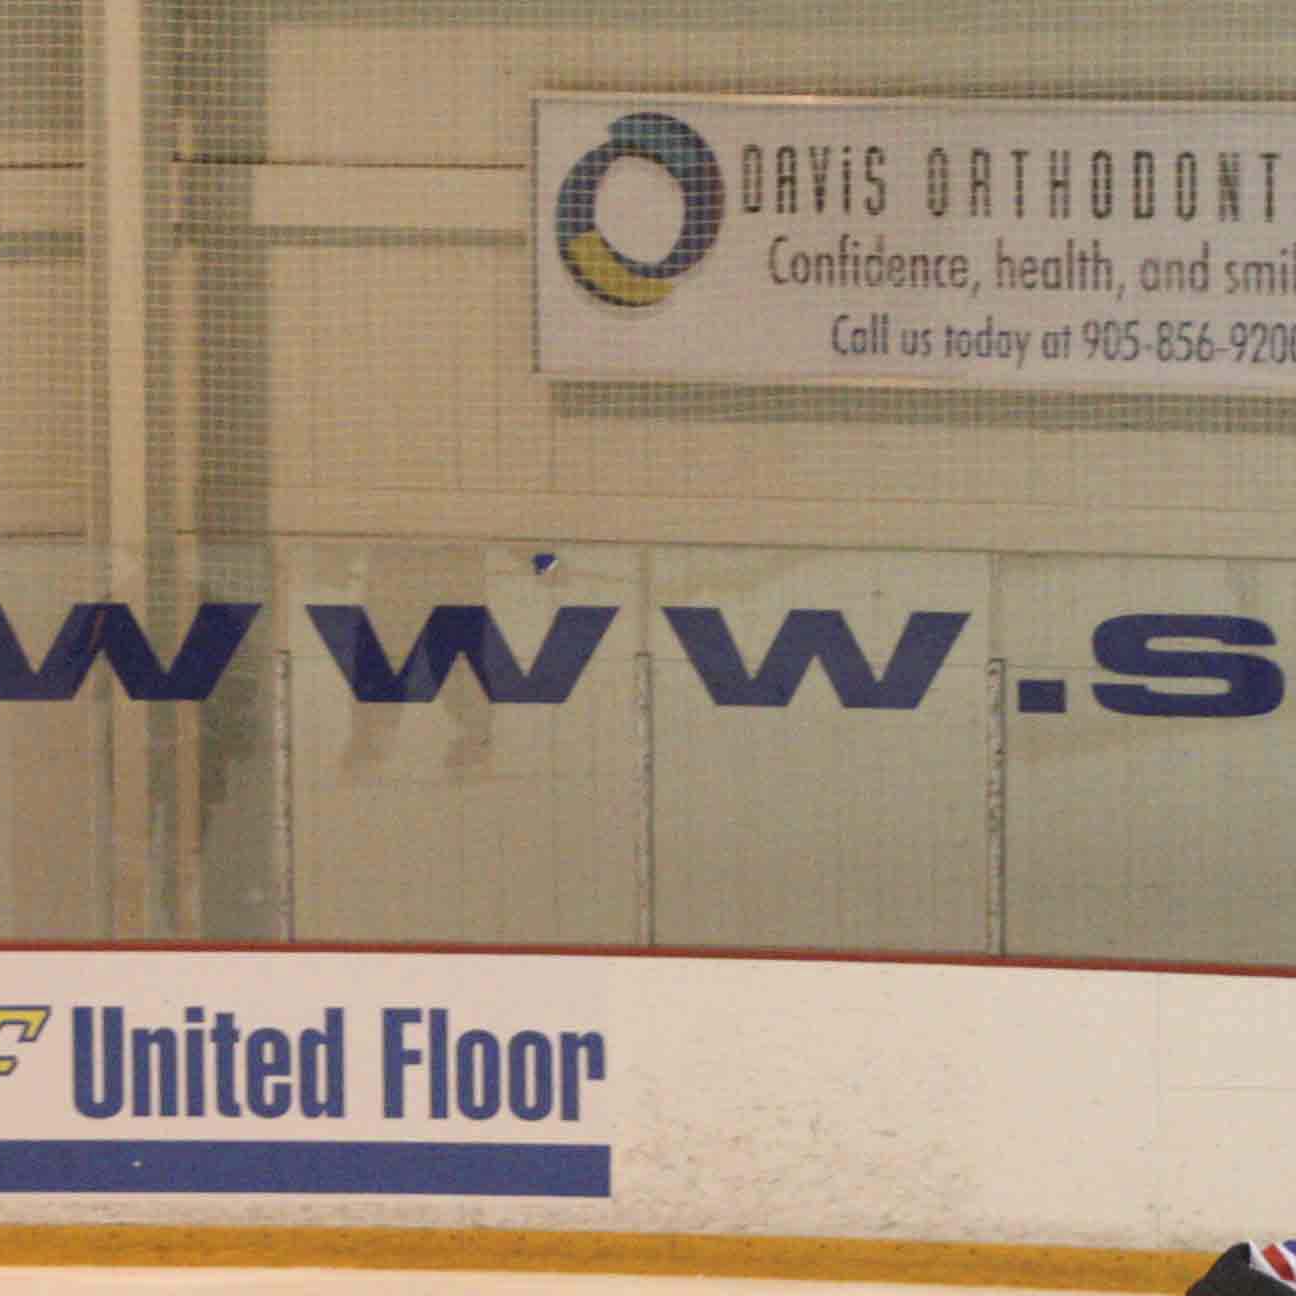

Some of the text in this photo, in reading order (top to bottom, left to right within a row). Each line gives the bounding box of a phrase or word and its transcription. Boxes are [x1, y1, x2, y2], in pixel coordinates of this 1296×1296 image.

[767, 234, 982, 299] Confidence,
[995, 236, 1126, 301] health,
[1138, 240, 1209, 293] and
[830, 312, 890, 356] Call
[900, 326, 933, 357] us
[943, 314, 1032, 370] today
[1041, 324, 1073, 360] at
[71, 1006, 606, 1123] United Floor
